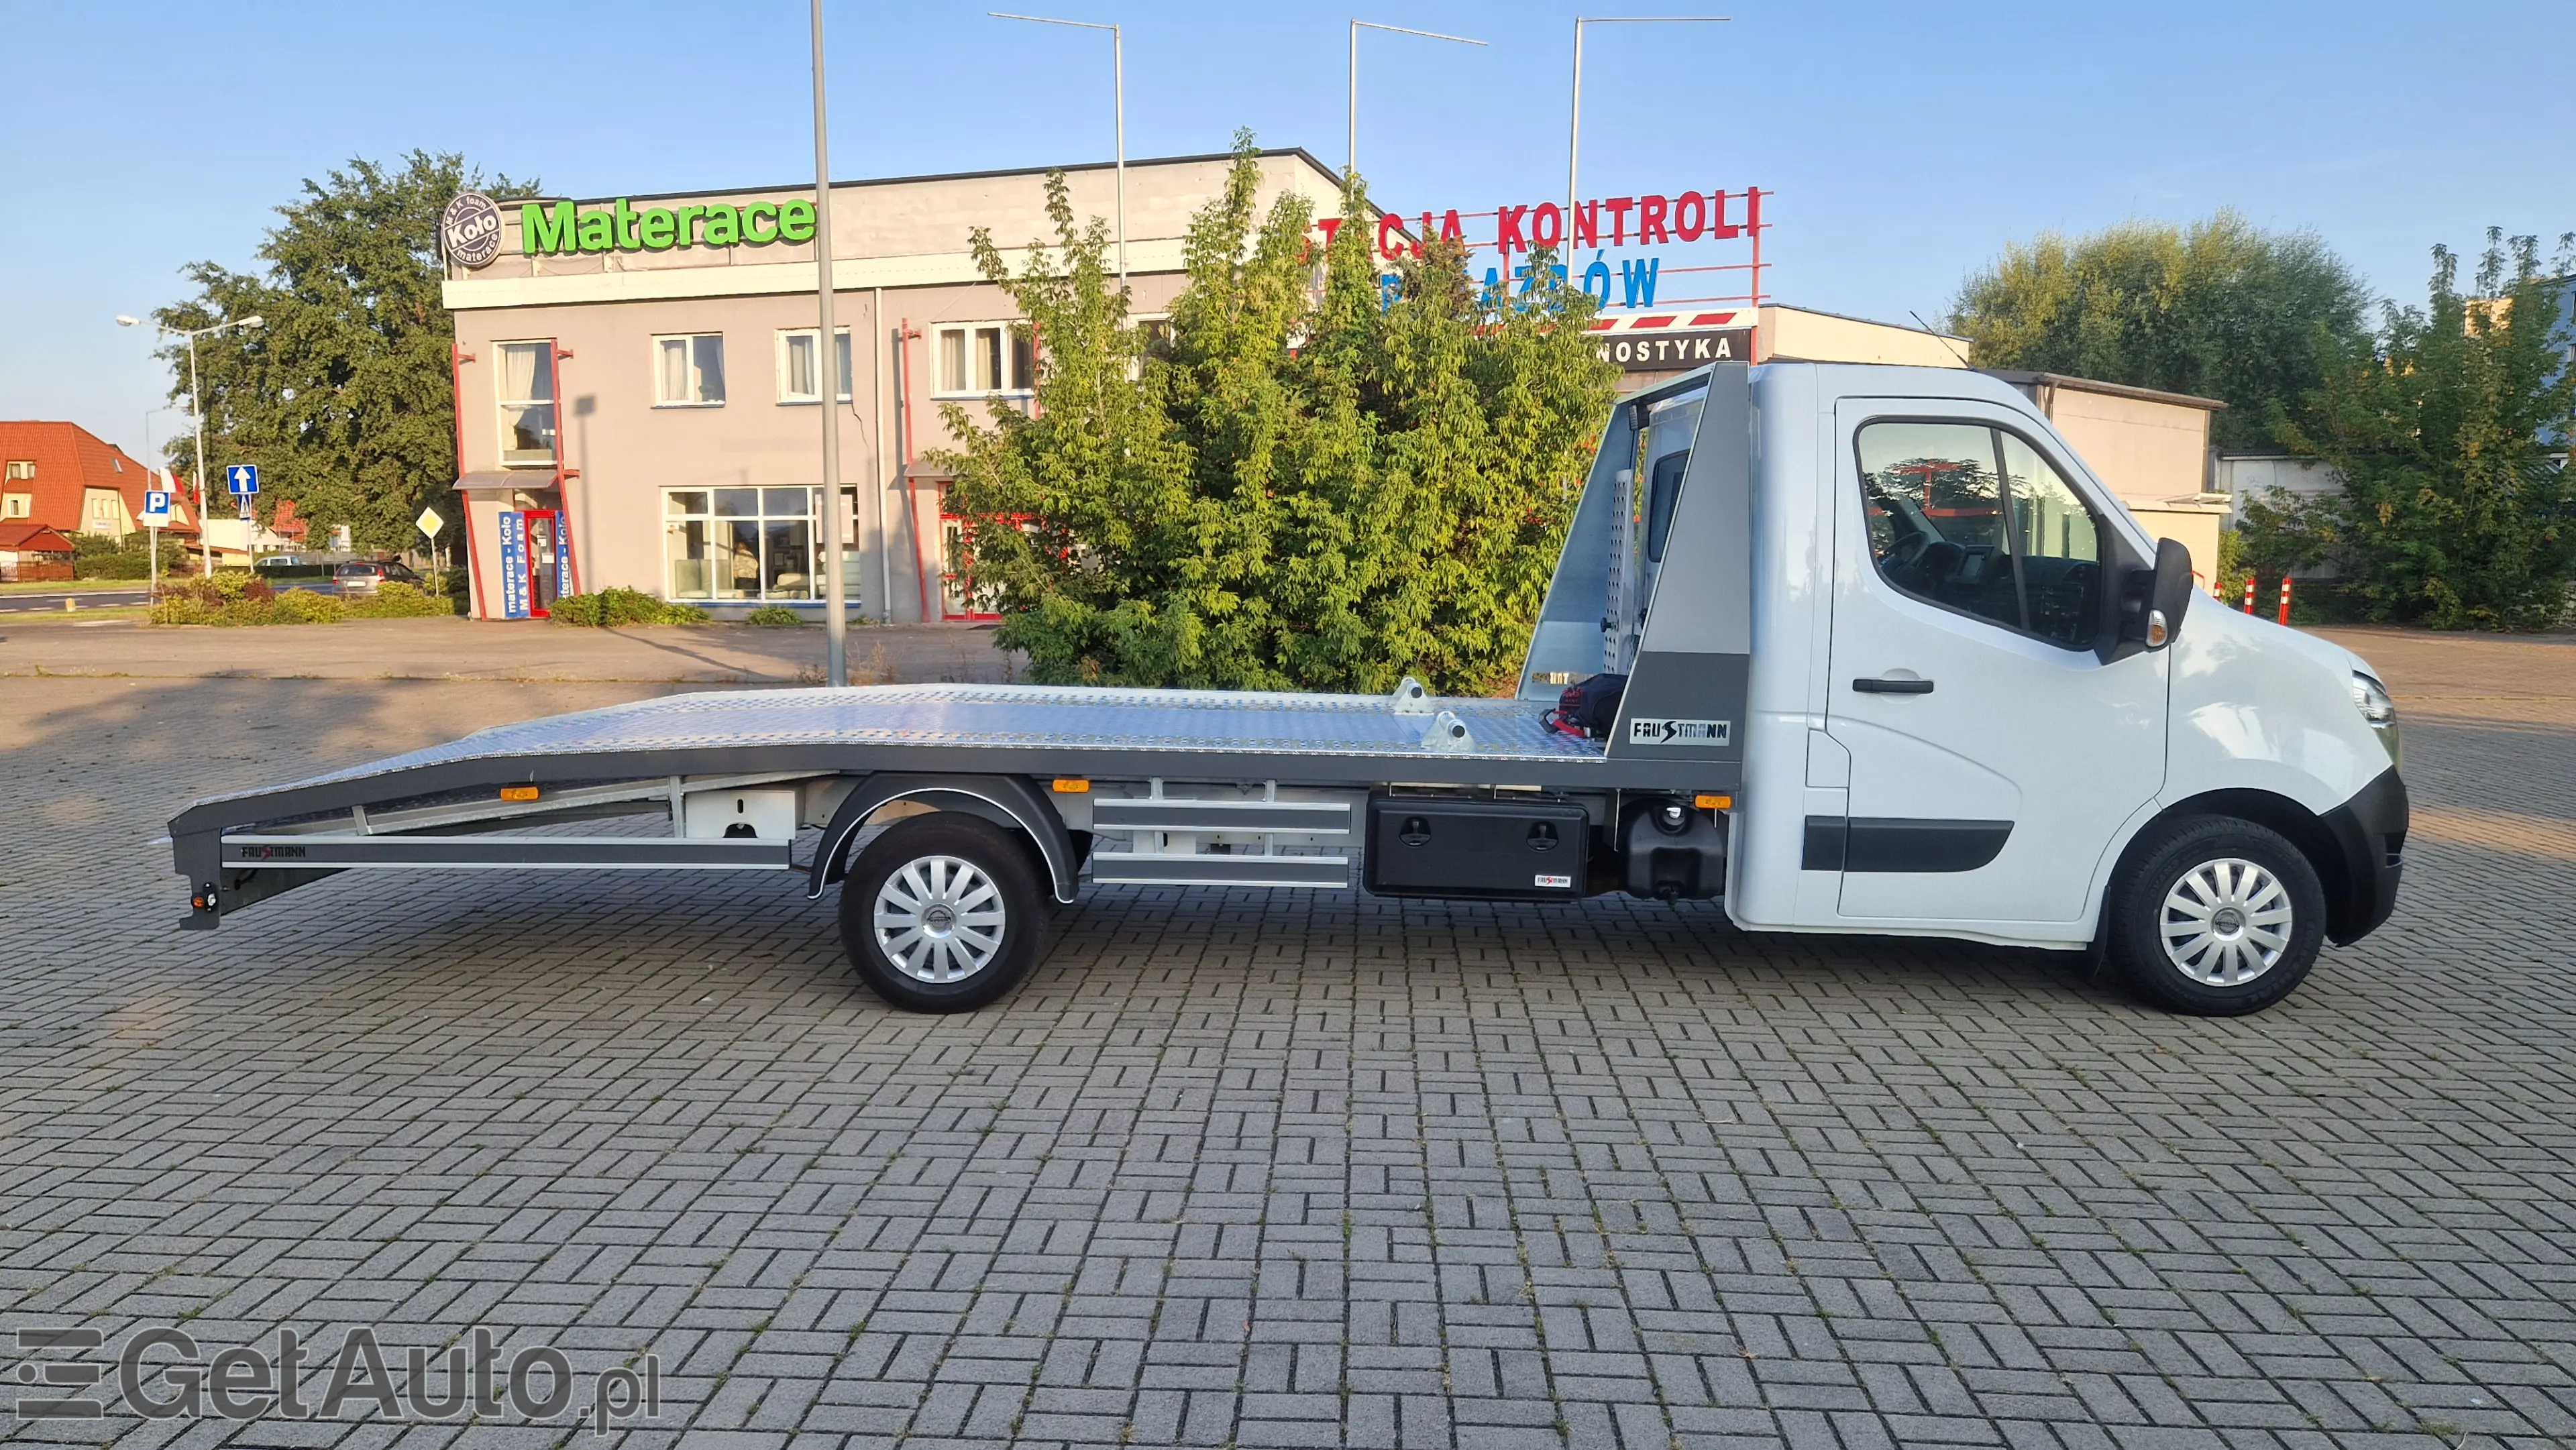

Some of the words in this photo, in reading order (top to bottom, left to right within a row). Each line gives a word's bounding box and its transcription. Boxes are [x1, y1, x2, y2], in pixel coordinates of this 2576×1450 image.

[449, 207, 458, 215] &
[455, 199, 464, 209] K
[466, 196, 487, 209] foam
[446, 215, 497, 248] Koło
[521, 198, 816, 254] Materace
[1293, 209, 1467, 265] STCJA
[1497, 186, 1758, 254] KONTROLI
[456, 233, 498, 262] materace
[1582, 337, 1731, 363] NOSTYKA
[150, 493, 166, 512] P
[516, 518, 526, 563] Foam
[505, 556, 517, 613] materace
[518, 573, 527, 583] K
[519, 585, 528, 596] &
[560, 556, 570, 599] terace
[519, 599, 528, 611] M
[1633, 721, 1727, 744] FAUSTMANN
[241, 845, 306, 861] FAUSTMANN
